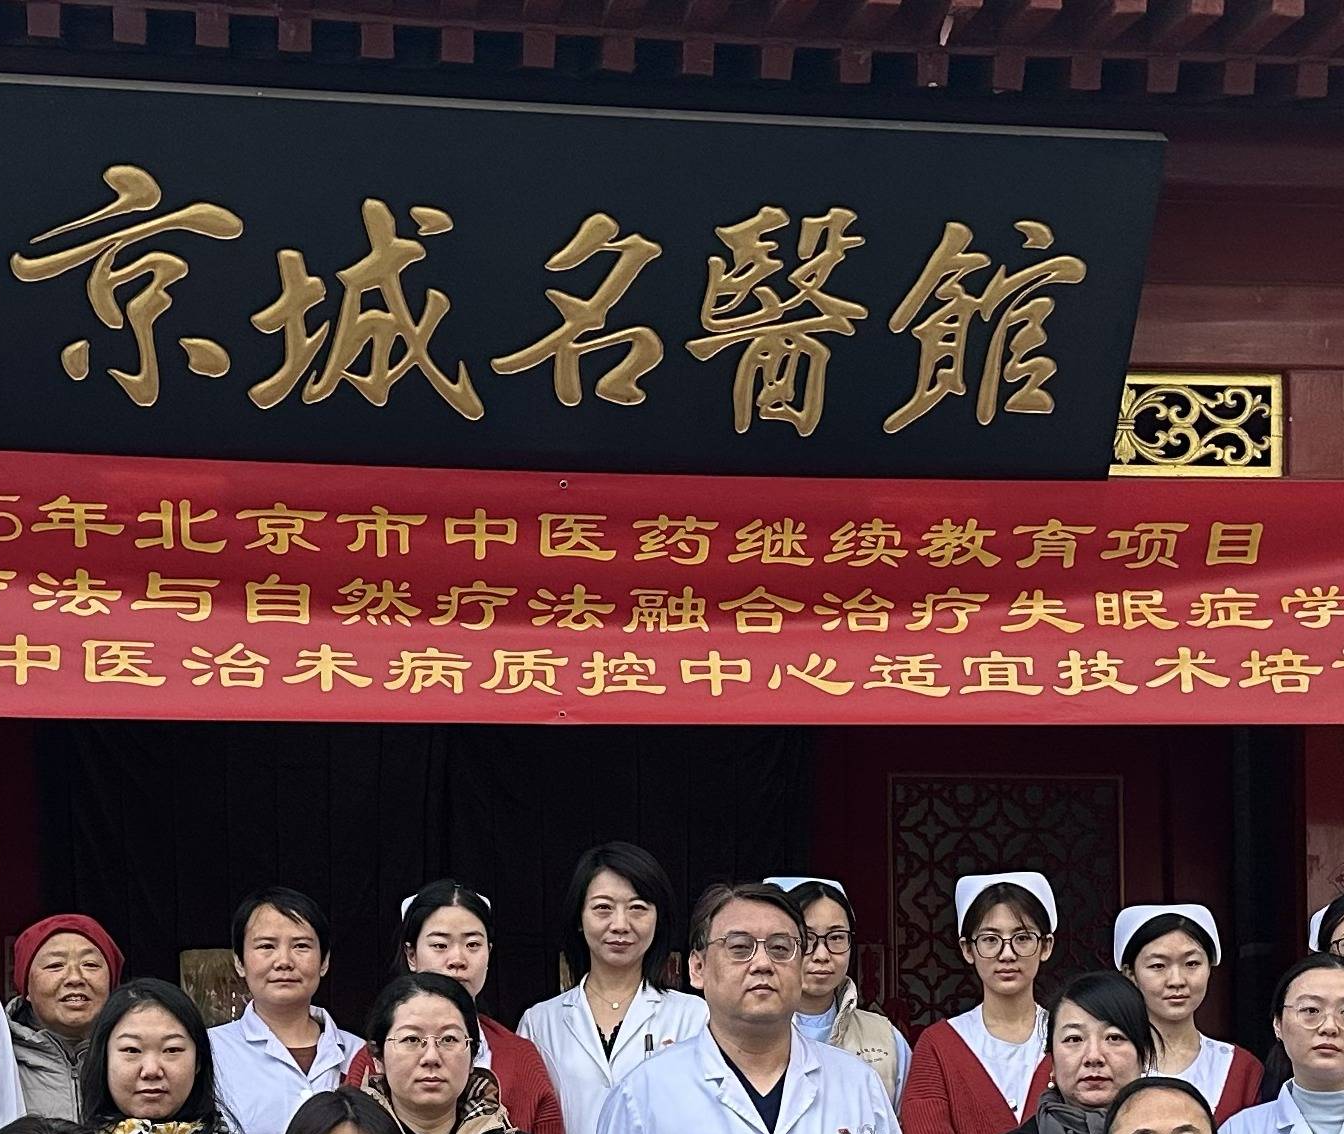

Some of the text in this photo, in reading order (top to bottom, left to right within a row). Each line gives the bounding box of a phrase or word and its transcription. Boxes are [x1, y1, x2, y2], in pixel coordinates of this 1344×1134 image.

[9, 165, 1086, 435] 京城名醫館
